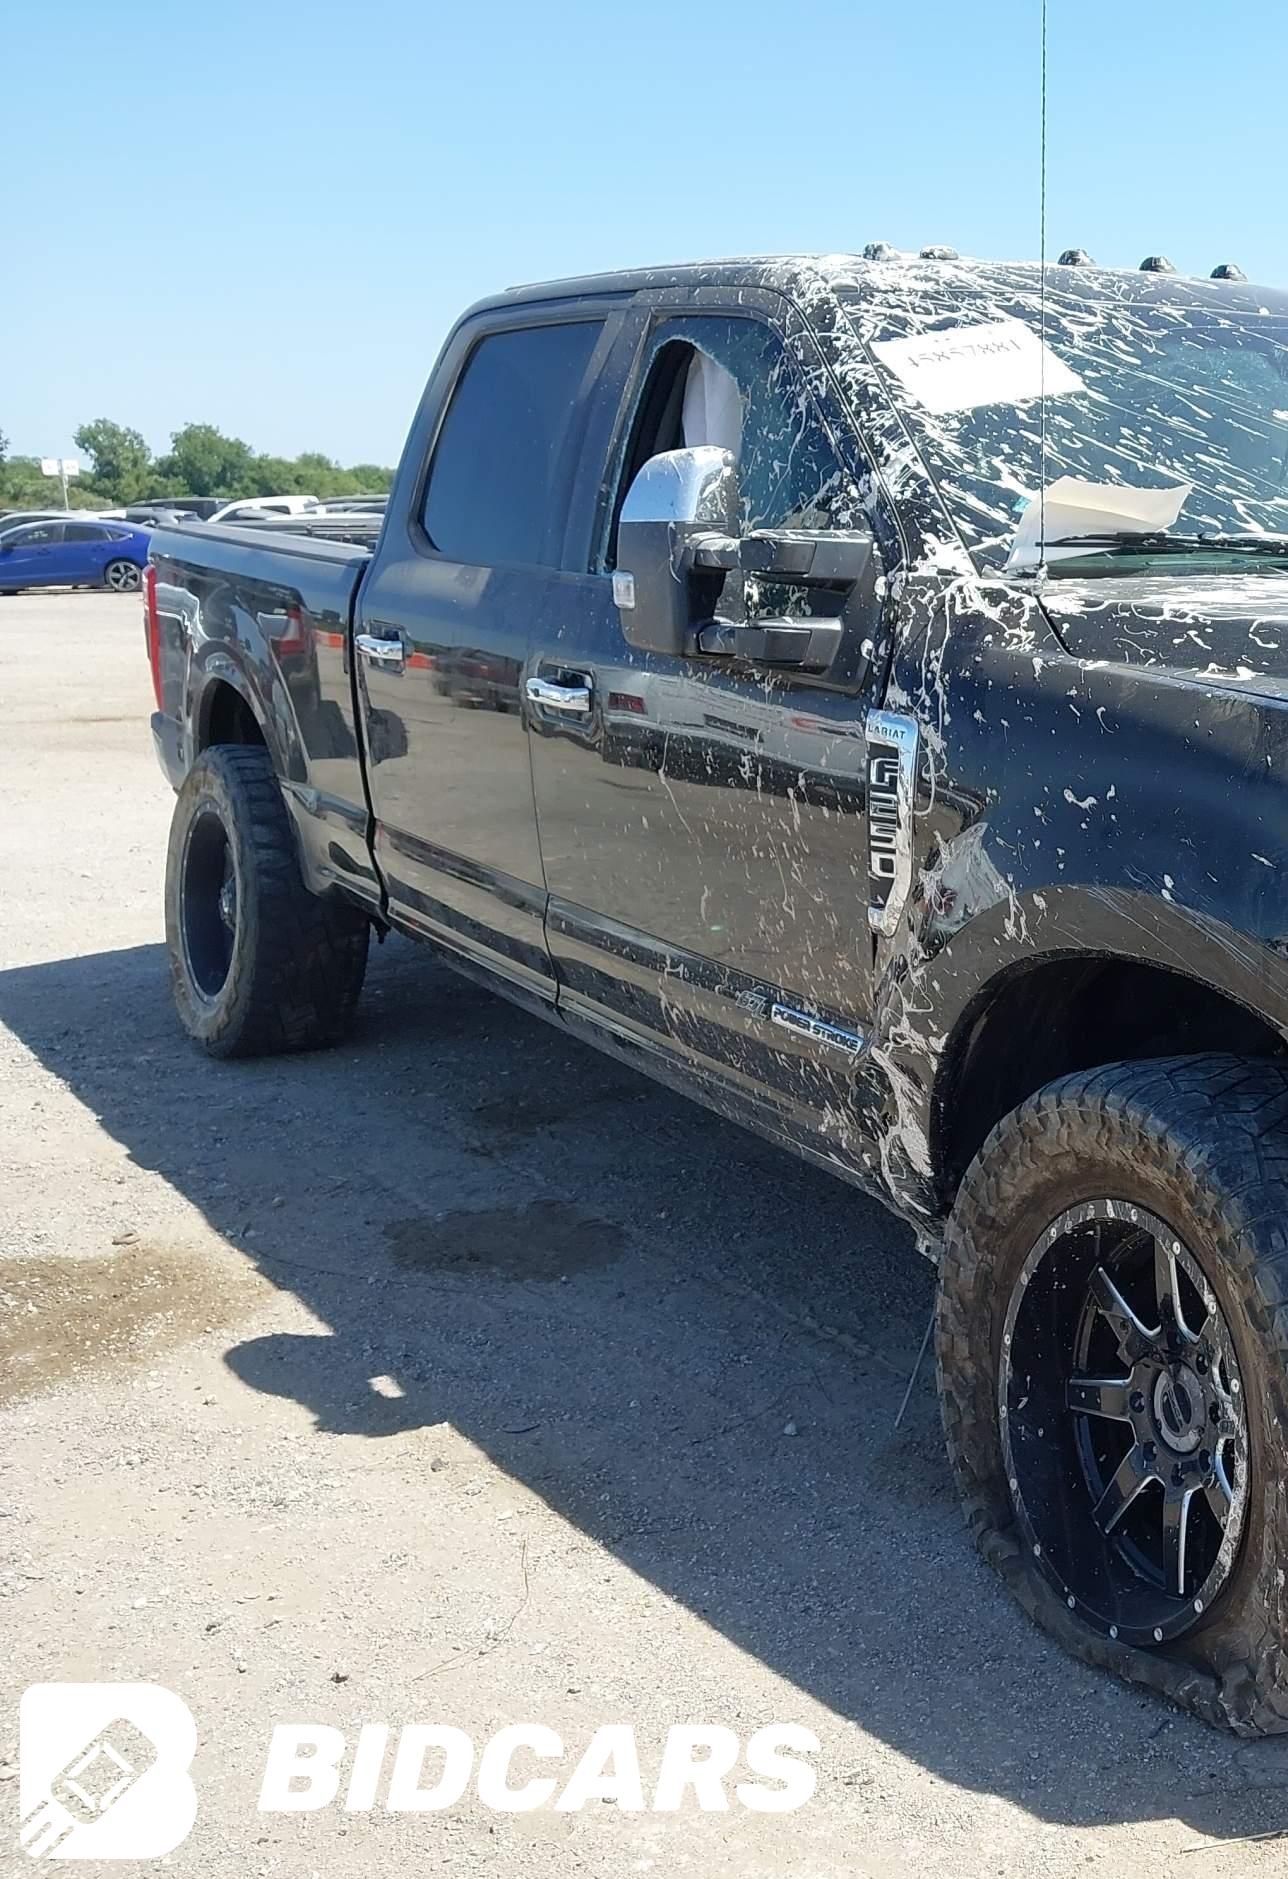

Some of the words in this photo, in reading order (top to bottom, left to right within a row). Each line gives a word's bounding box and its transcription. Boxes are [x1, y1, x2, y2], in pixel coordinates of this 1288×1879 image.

[868, 724, 906, 740] LARIAT
[773, 1006, 812, 1033] POWER
[811, 1024, 860, 1054] STROKE
